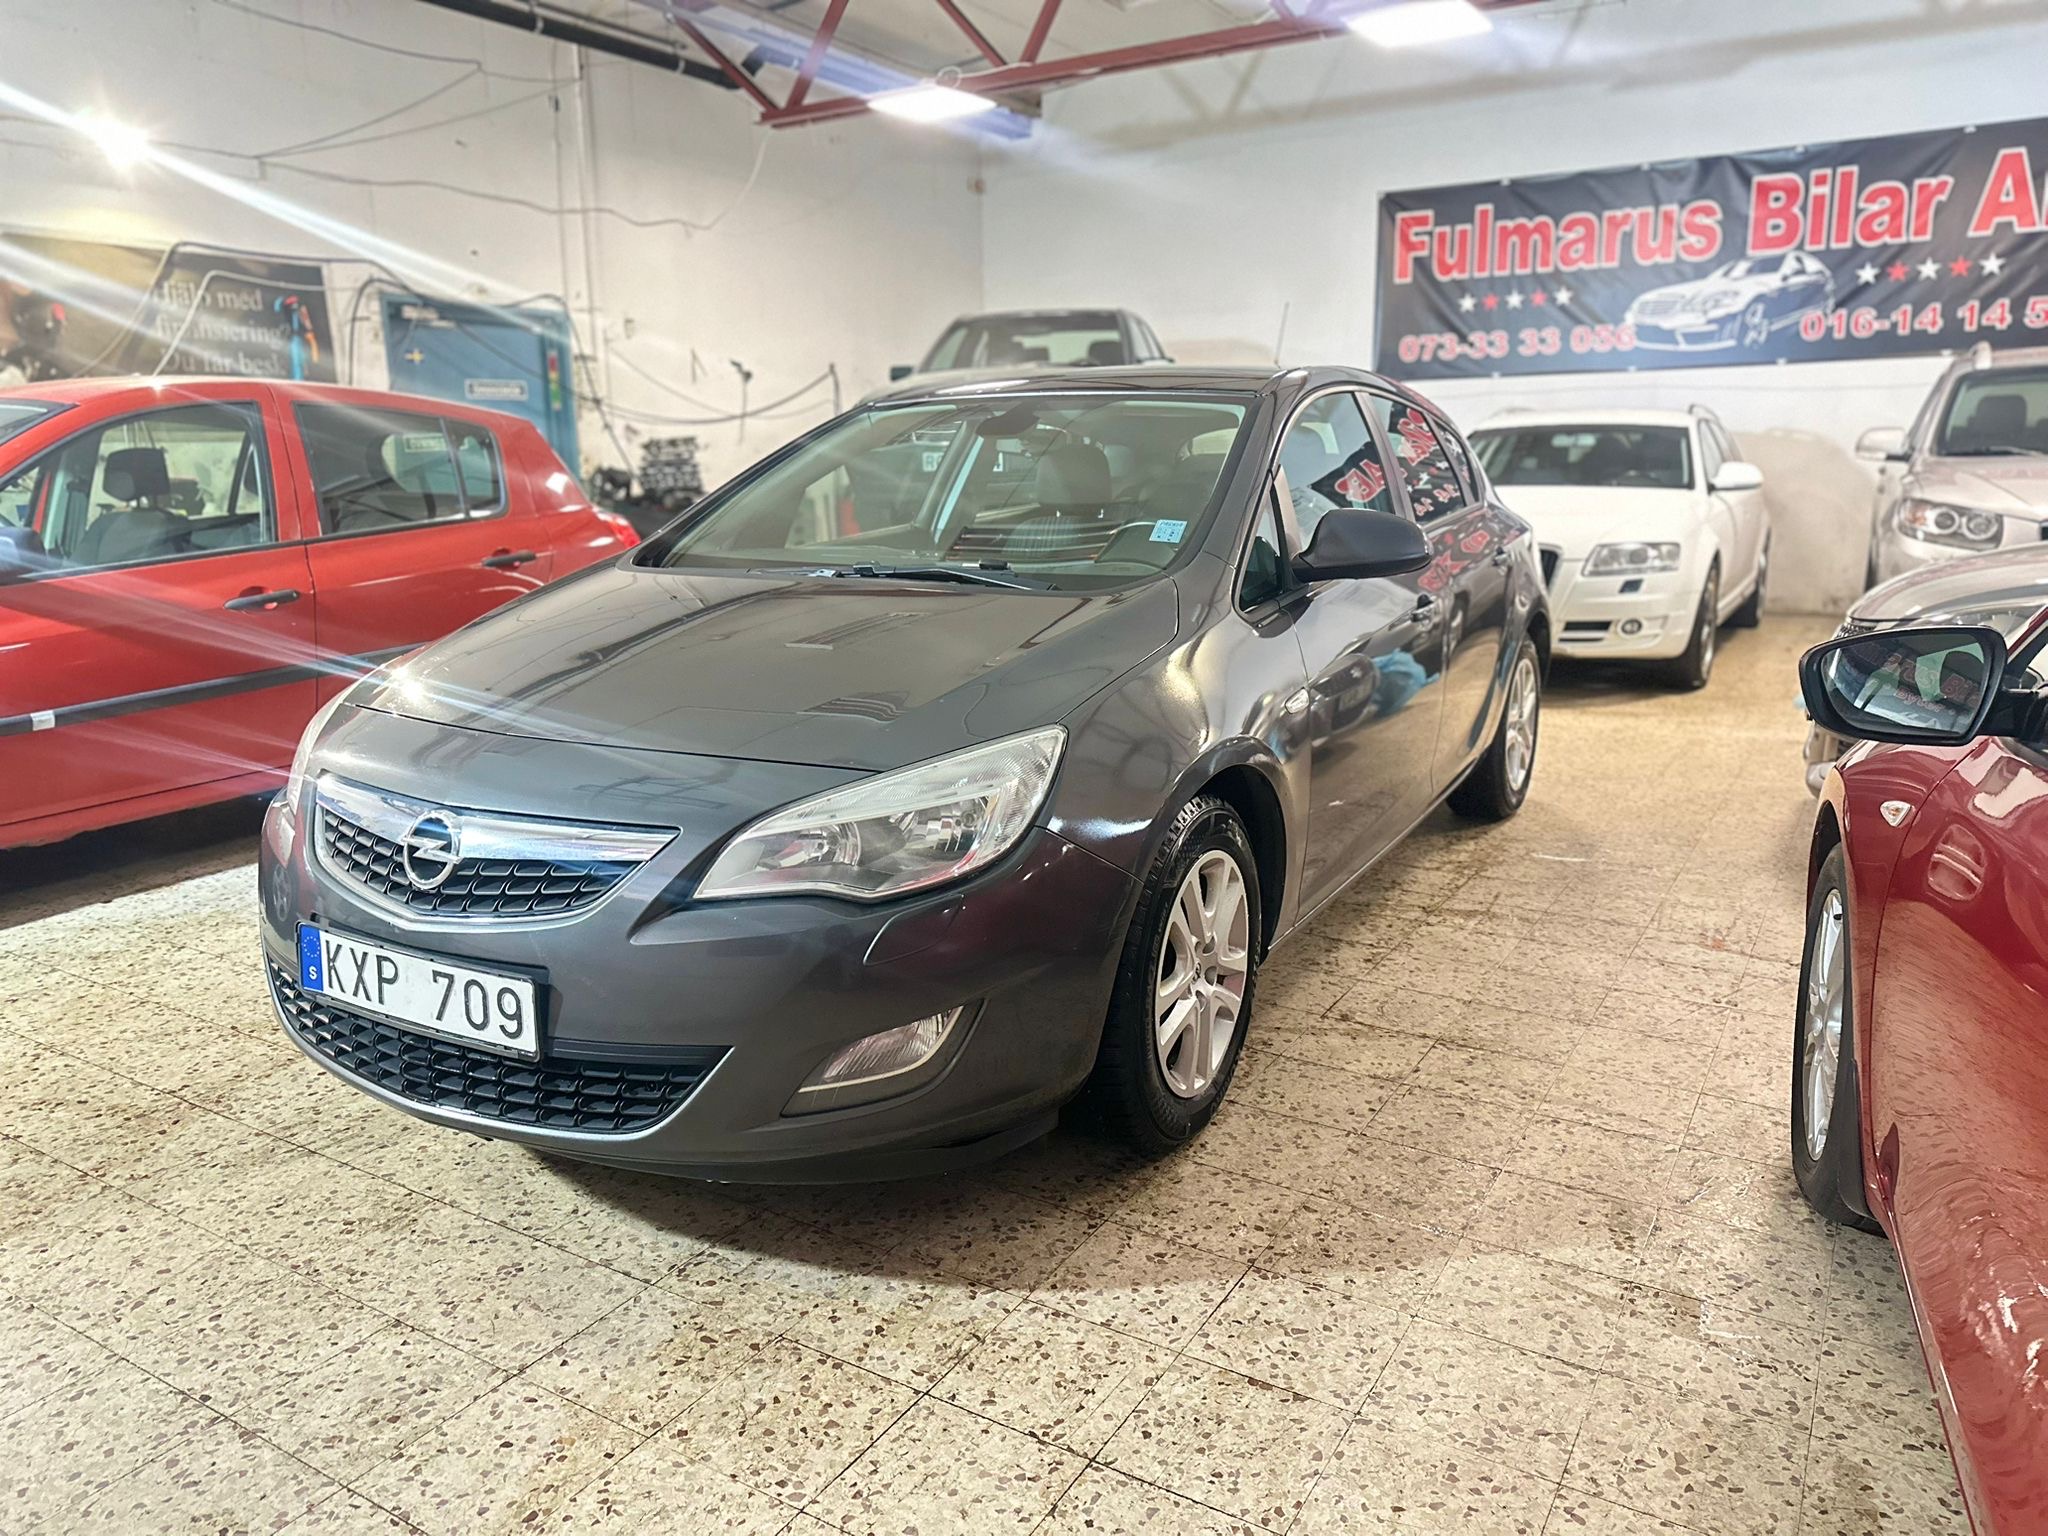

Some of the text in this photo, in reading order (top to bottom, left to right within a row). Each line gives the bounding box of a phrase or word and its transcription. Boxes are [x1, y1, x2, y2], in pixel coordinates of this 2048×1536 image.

[1394, 146, 2048, 284] Fulmarus Bilar A
[217, 289, 263, 312] med
[1800, 303, 1944, 342] 016-14
[1957, 298, 2012, 332] 14
[1519, 326, 1561, 354] 33
[308, 965, 319, 981] S
[325, 939, 524, 1040] KXP 709
